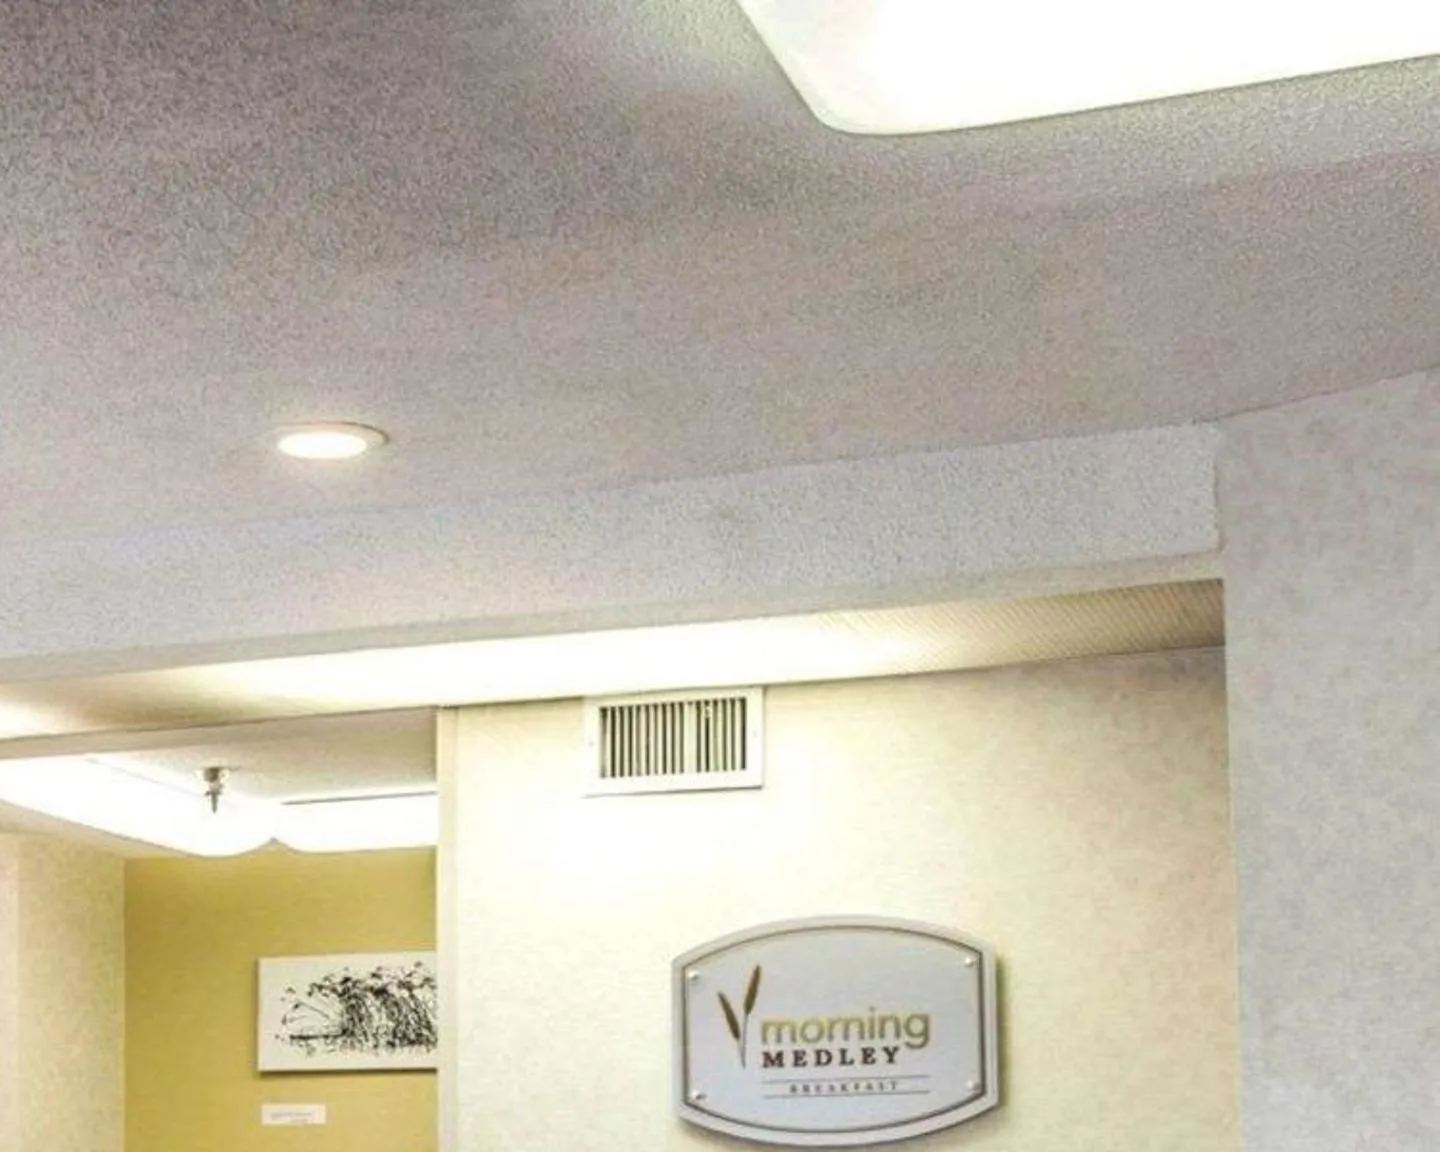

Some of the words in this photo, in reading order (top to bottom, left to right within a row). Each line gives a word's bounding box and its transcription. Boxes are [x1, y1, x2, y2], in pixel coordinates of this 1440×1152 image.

[762, 1006, 929, 1049] morning
[762, 1045, 899, 1068] MEDLEY
[789, 1080, 898, 1094] BREAKFAST
